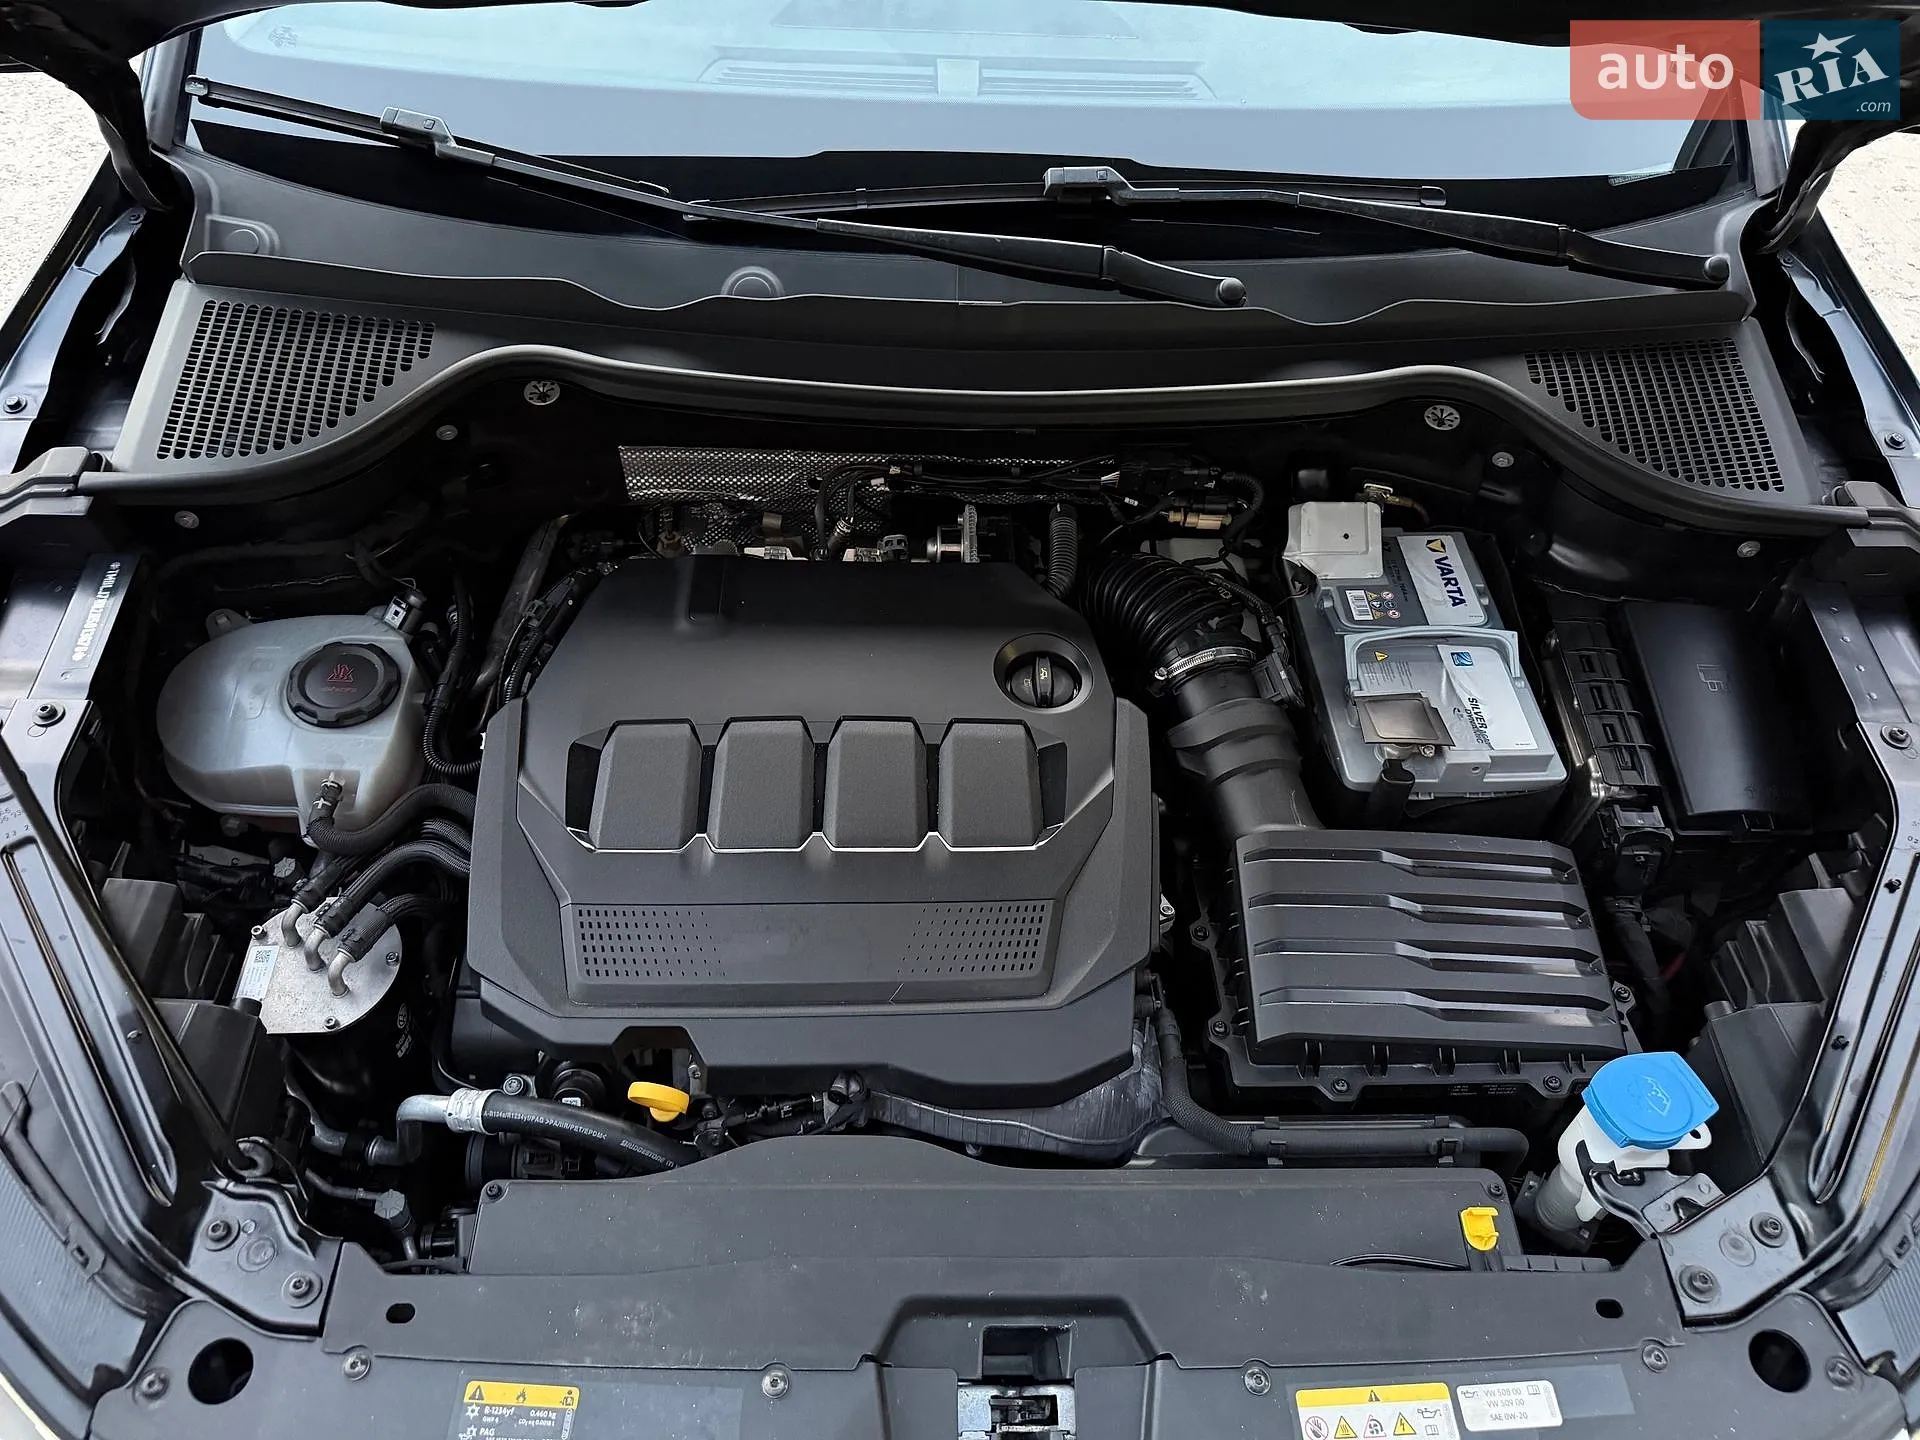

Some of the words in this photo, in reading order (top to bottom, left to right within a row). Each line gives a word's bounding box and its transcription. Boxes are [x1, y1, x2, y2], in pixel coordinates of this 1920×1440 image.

[1434, 555, 1467, 608] VARTA
[1467, 697, 1488, 731] SILVER
[1483, 1389, 1496, 1397] VW
[1497, 1388, 1511, 1396] 508
[1486, 1400, 1499, 1408] VW
[484, 1406, 515, 1417] R-1234yf
[1489, 1413, 1503, 1421] SAE
[479, 1428, 495, 1436] PAG
